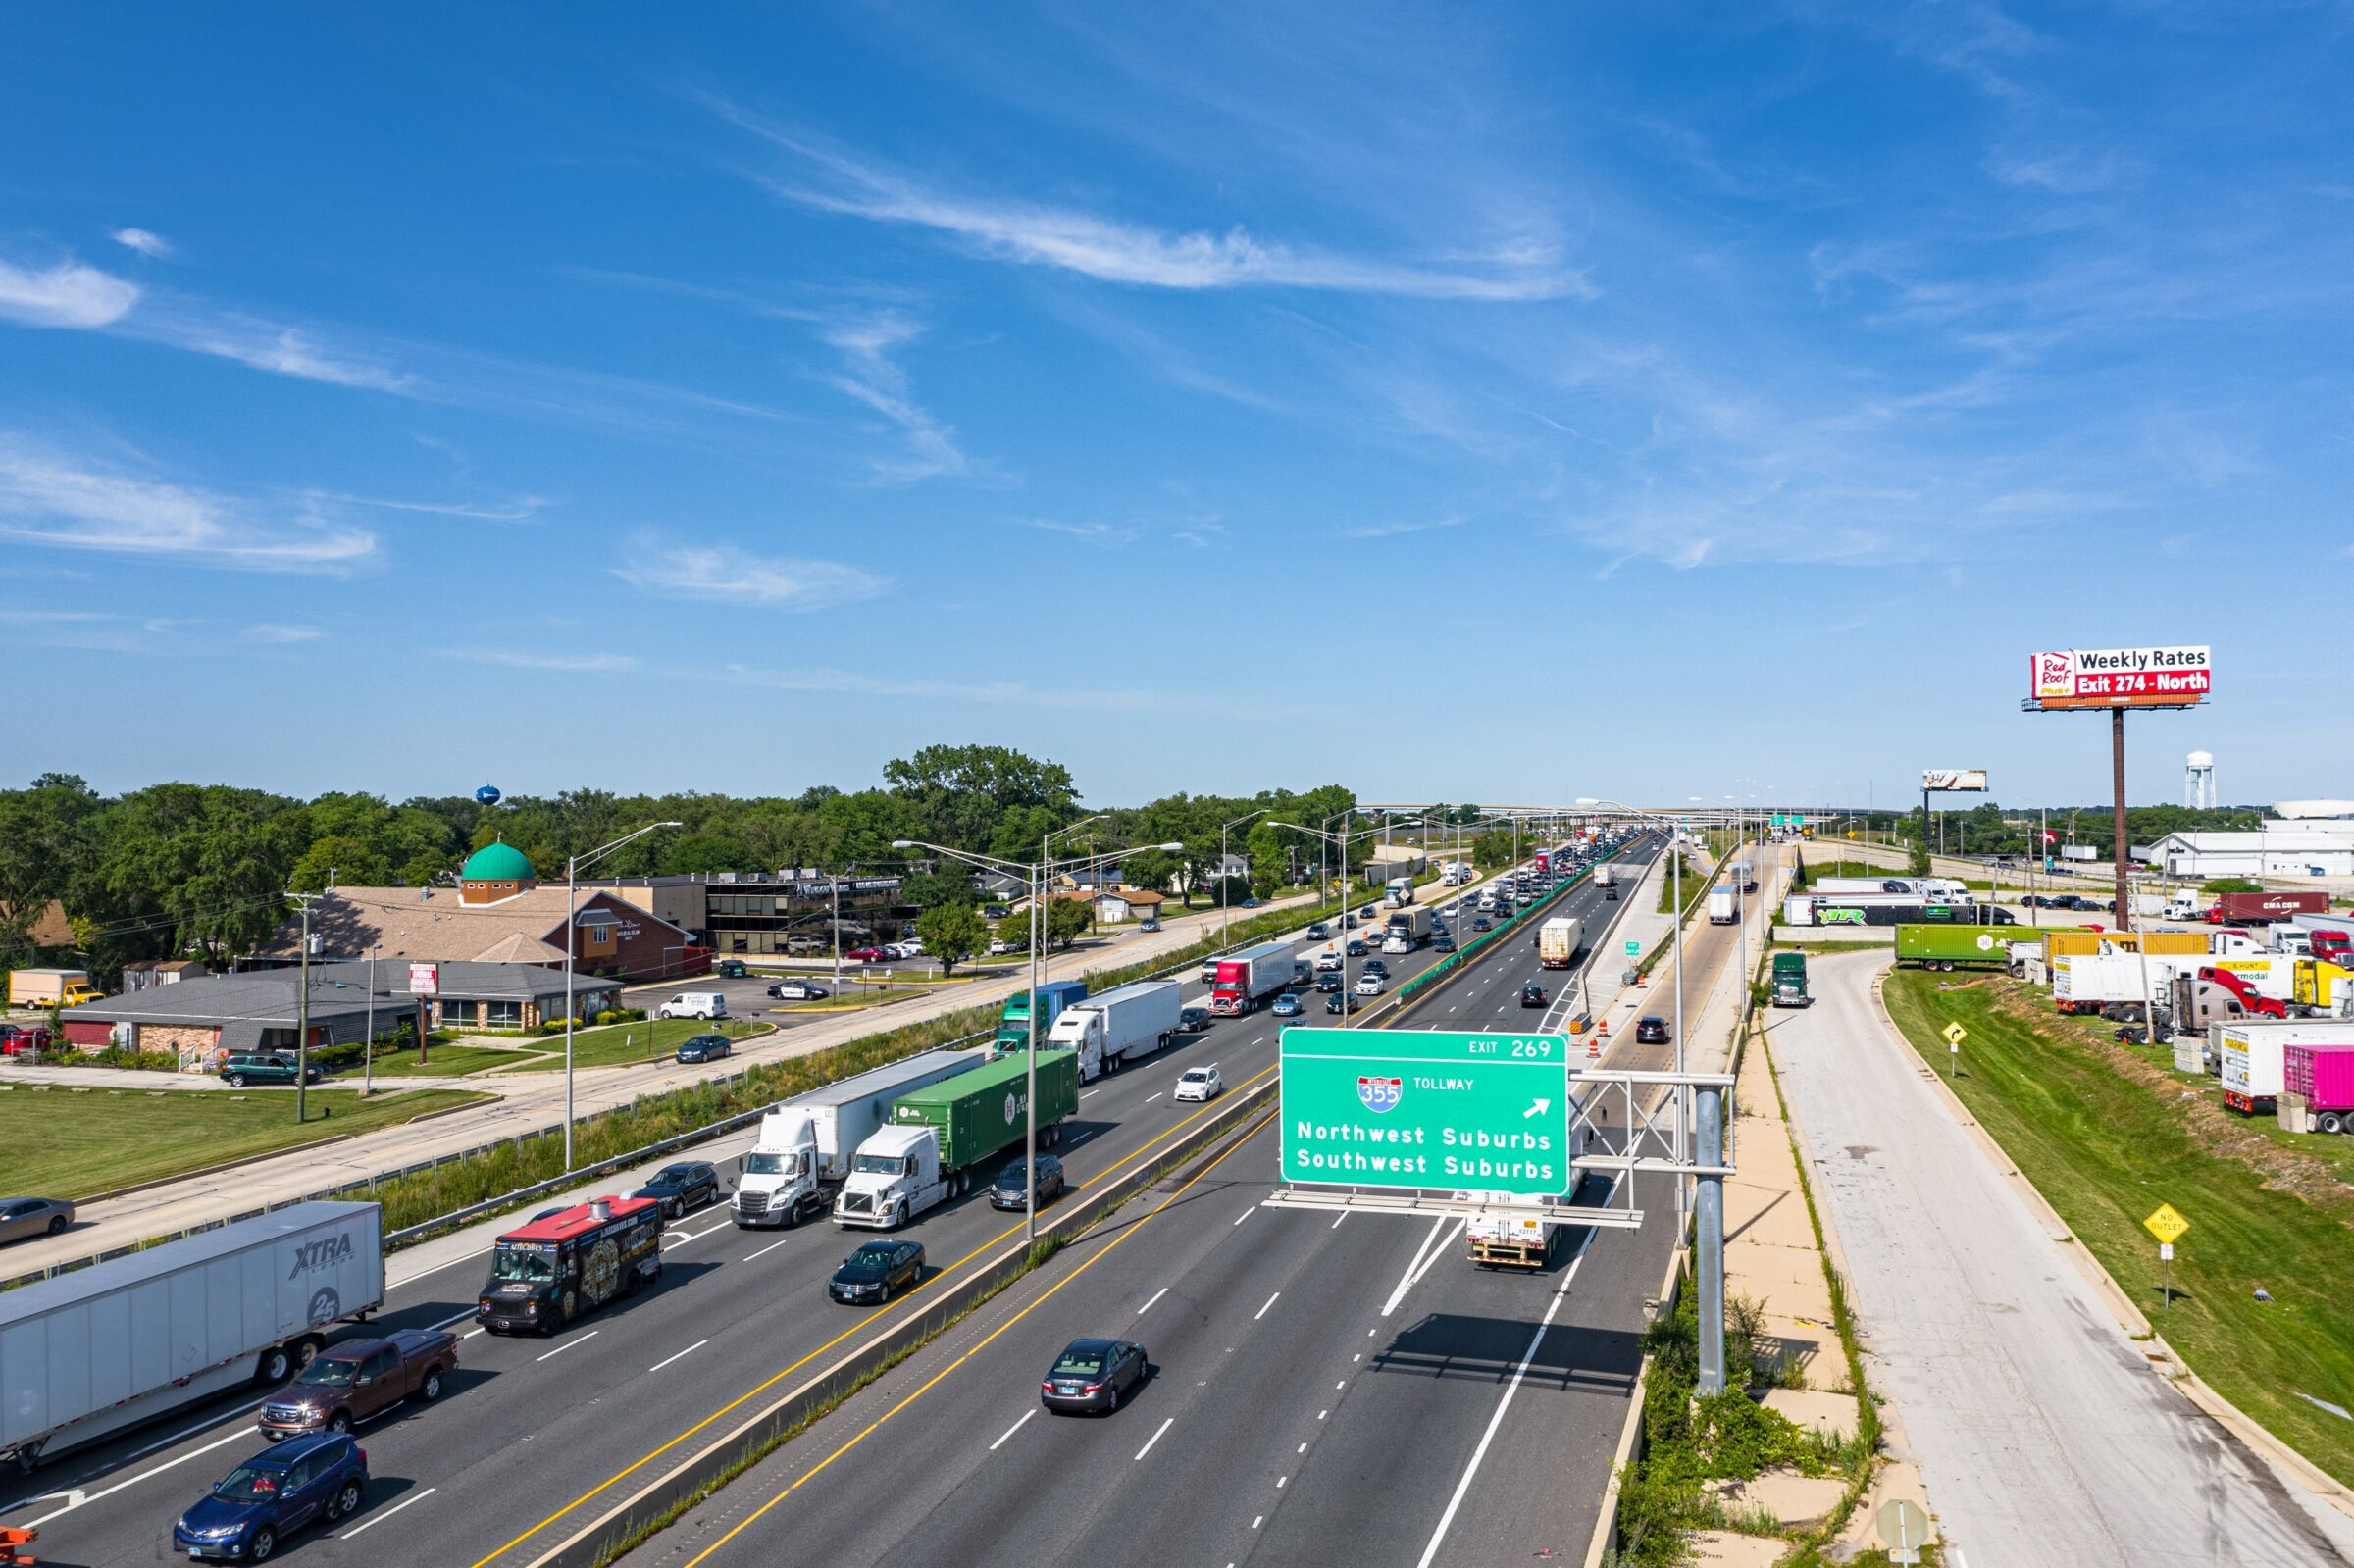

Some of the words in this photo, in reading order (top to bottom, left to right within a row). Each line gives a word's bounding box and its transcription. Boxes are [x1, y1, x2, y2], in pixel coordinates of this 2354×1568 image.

[2044, 659, 2066, 672] Red
[2080, 651, 2148, 671] Weekly
[2153, 651, 2206, 666] Rates
[2042, 670, 2072, 685] Roof
[2078, 676, 2111, 693] Exit
[1469, 1041, 1498, 1054] EXIT
[1511, 1039, 1551, 1058] 269
[1413, 1077, 1474, 1090] TOLLWAY
[1361, 1085, 1399, 1103] 355
[1297, 1121, 1424, 1144] Northwest
[1442, 1128, 1551, 1150] Suburbs
[1297, 1149, 1426, 1174] Southwest
[1444, 1156, 1553, 1179] Suburbs
[288, 1233, 351, 1280] XTRA
[314, 1293, 335, 1321] 25
